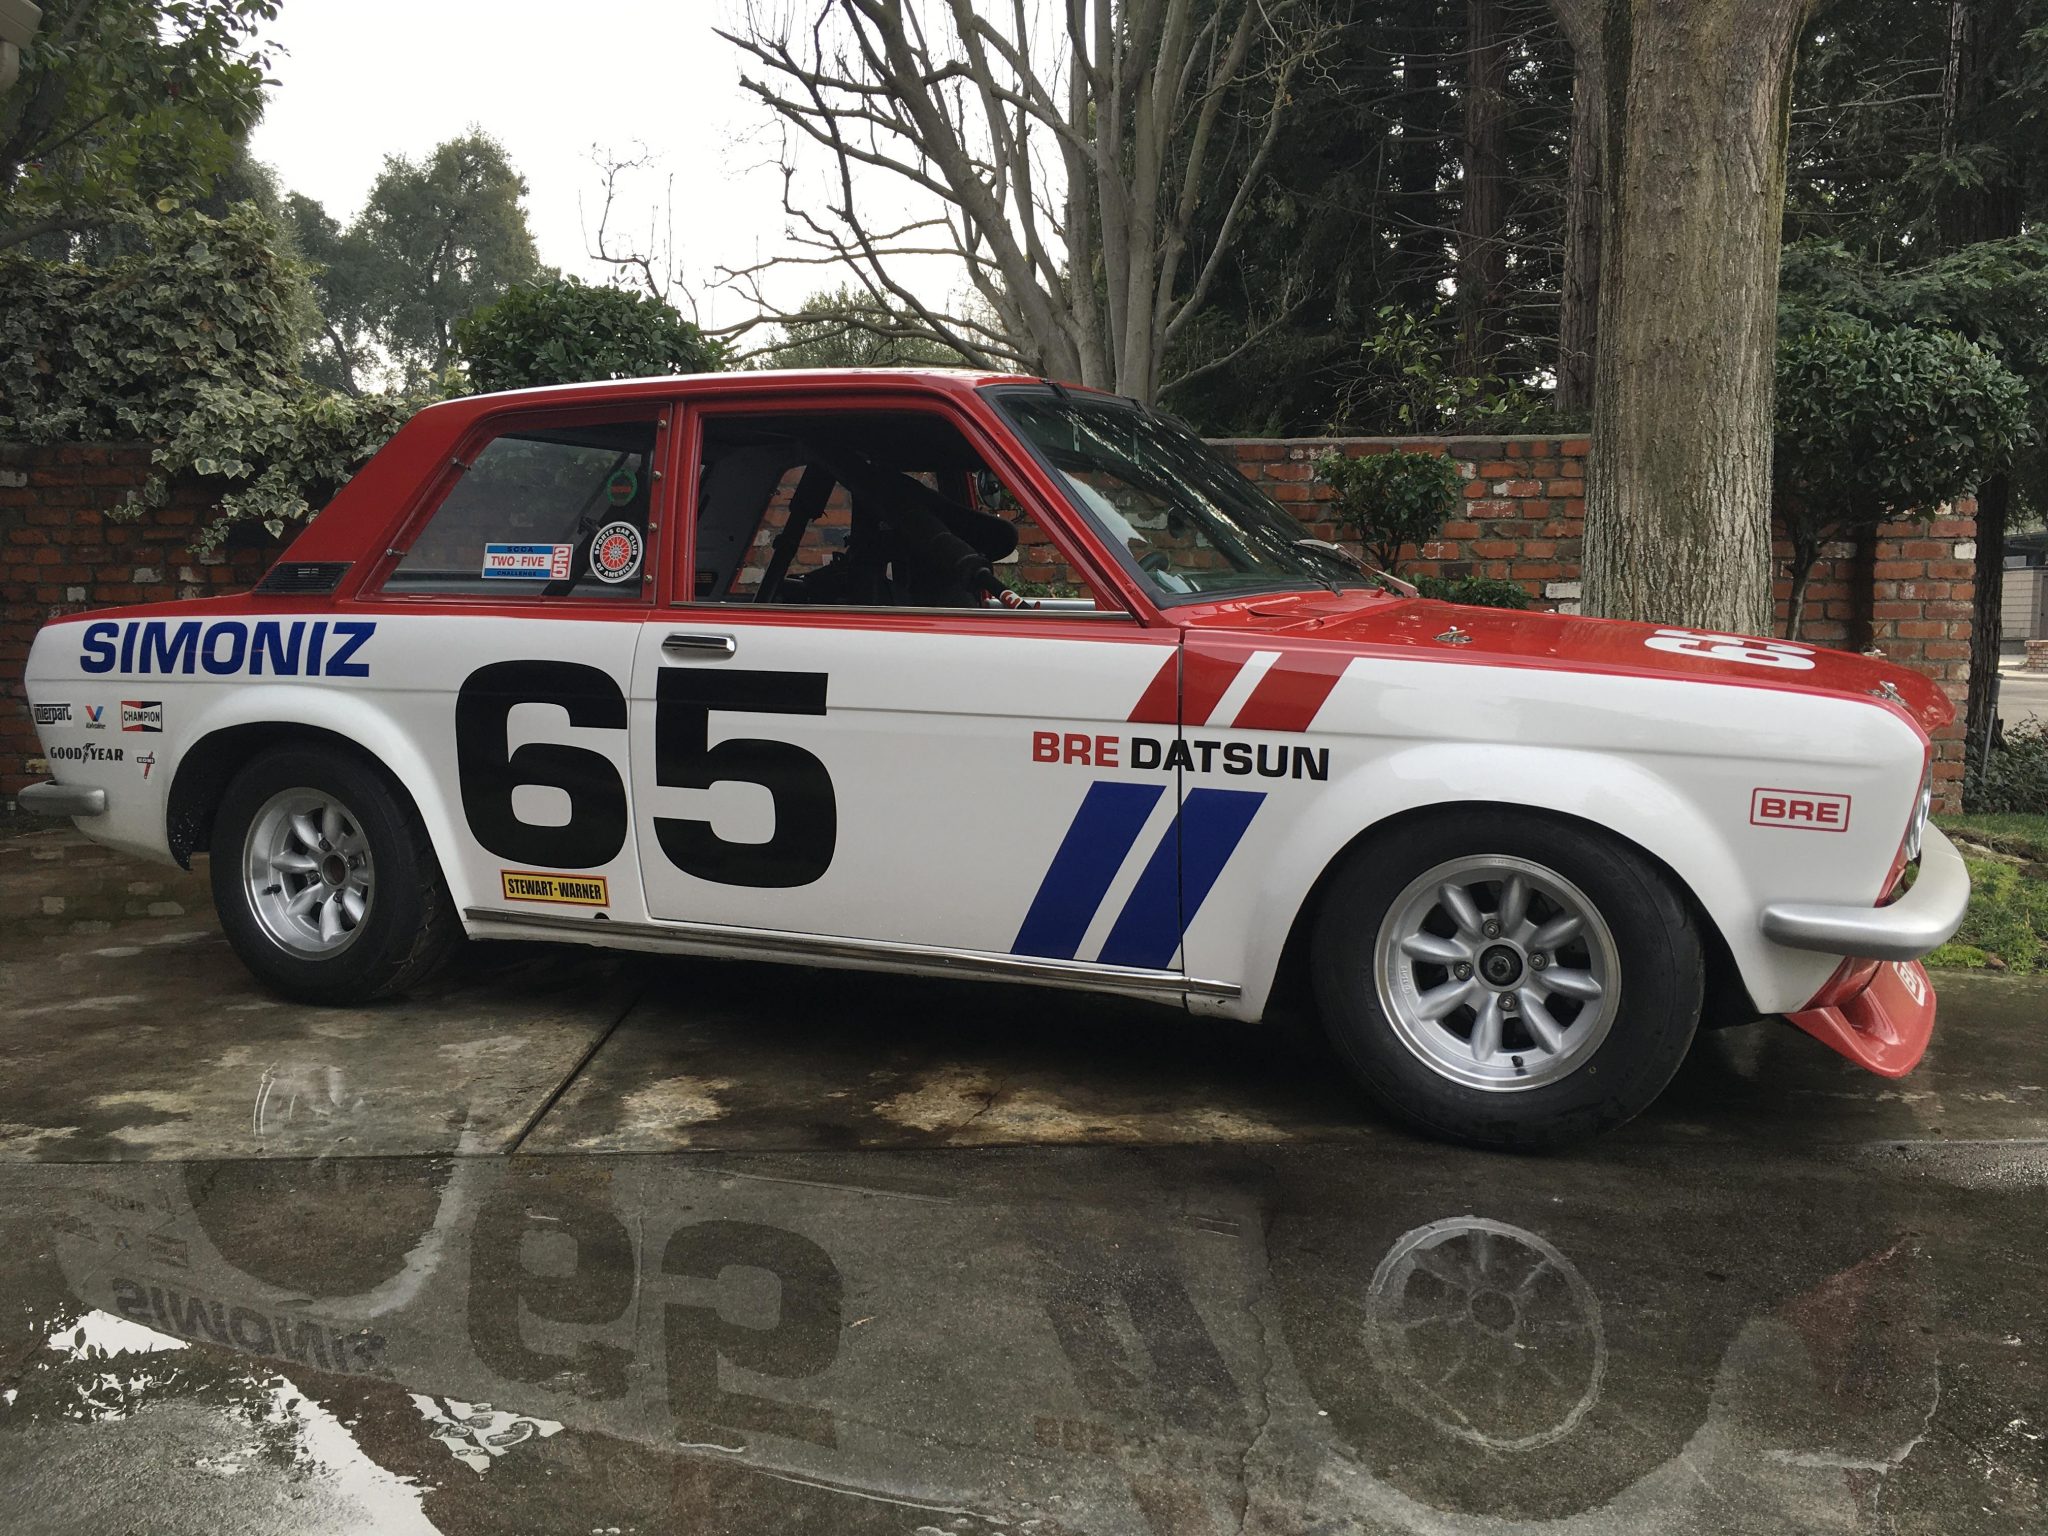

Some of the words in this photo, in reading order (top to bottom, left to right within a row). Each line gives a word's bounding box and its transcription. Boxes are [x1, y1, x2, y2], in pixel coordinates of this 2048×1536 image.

[595, 527, 614, 555] SPORTS
[616, 527, 630, 536] CAR
[629, 535, 638, 556] CLUB
[596, 562, 605, 572] OF
[603, 561, 634, 578] AMERICA
[80, 621, 377, 677] SIMONIZ
[124, 710, 160, 723] CHAMPION
[1032, 731, 1119, 767] BRE
[1131, 737, 1330, 781] DATSUN
[455, 659, 837, 888] 65
[1760, 797, 1840, 823] BRE
[508, 878, 602, 900] STEWART-WARNER
